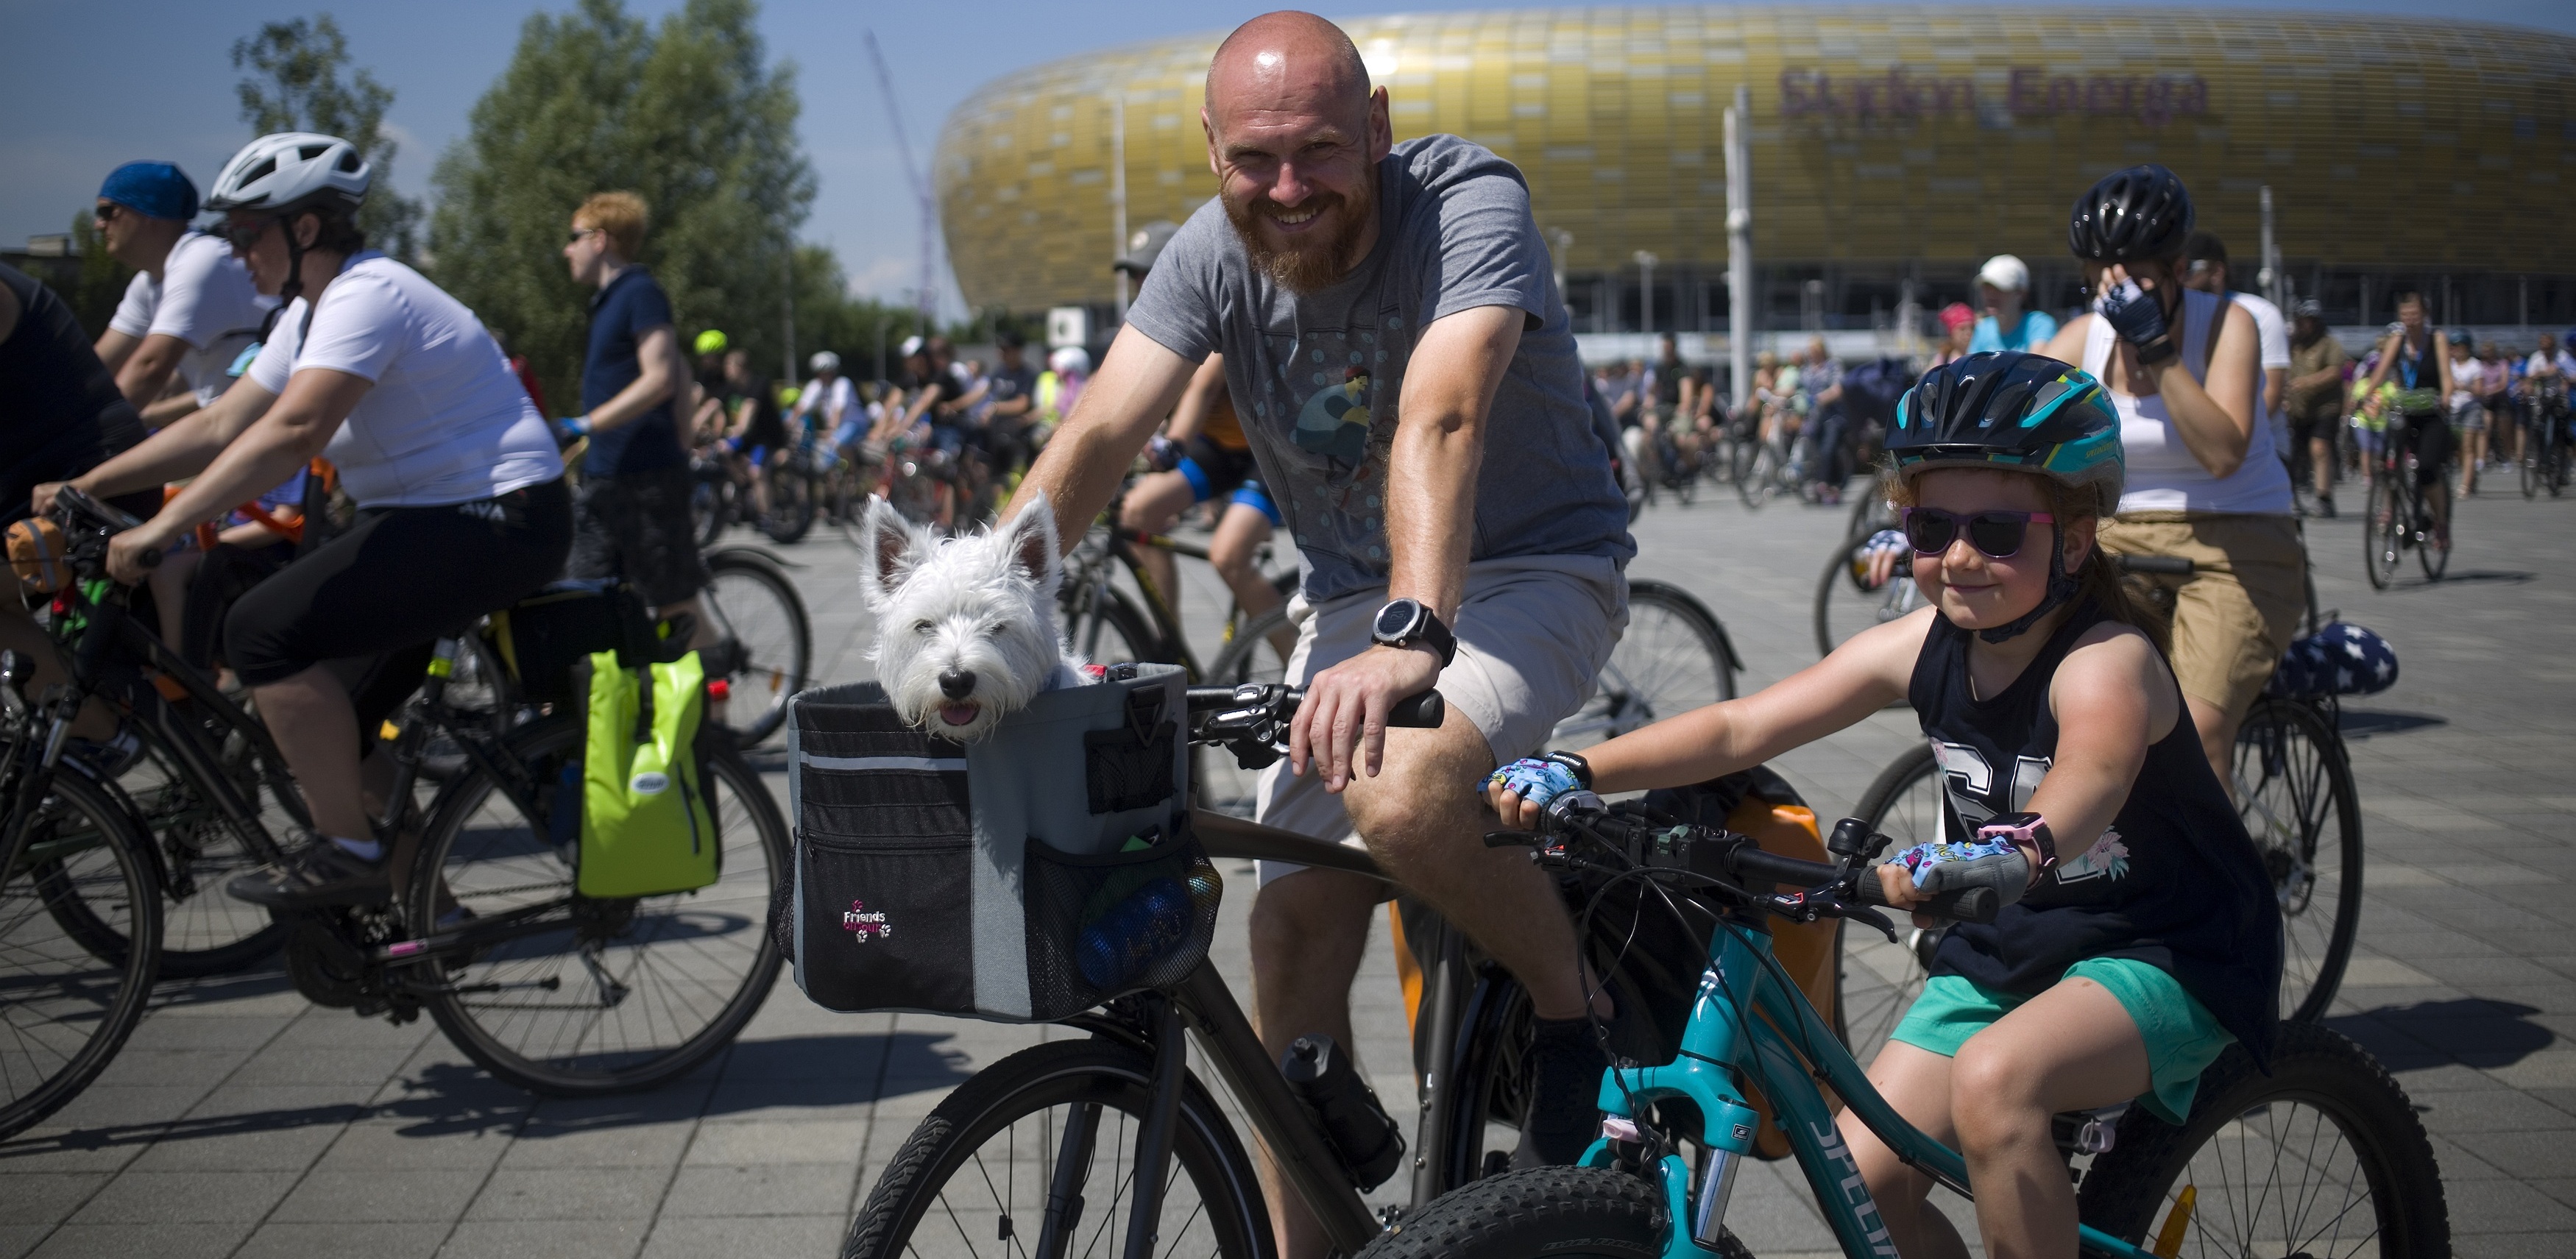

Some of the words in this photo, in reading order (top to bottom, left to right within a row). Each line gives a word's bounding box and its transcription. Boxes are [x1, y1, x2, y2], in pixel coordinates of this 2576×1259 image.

[2009, 68, 2209, 126] Energa
[844, 909, 885, 923] Friends
[1426, 1073, 1433, 1088] L
[1541, 1238, 1590, 1252] BIG
